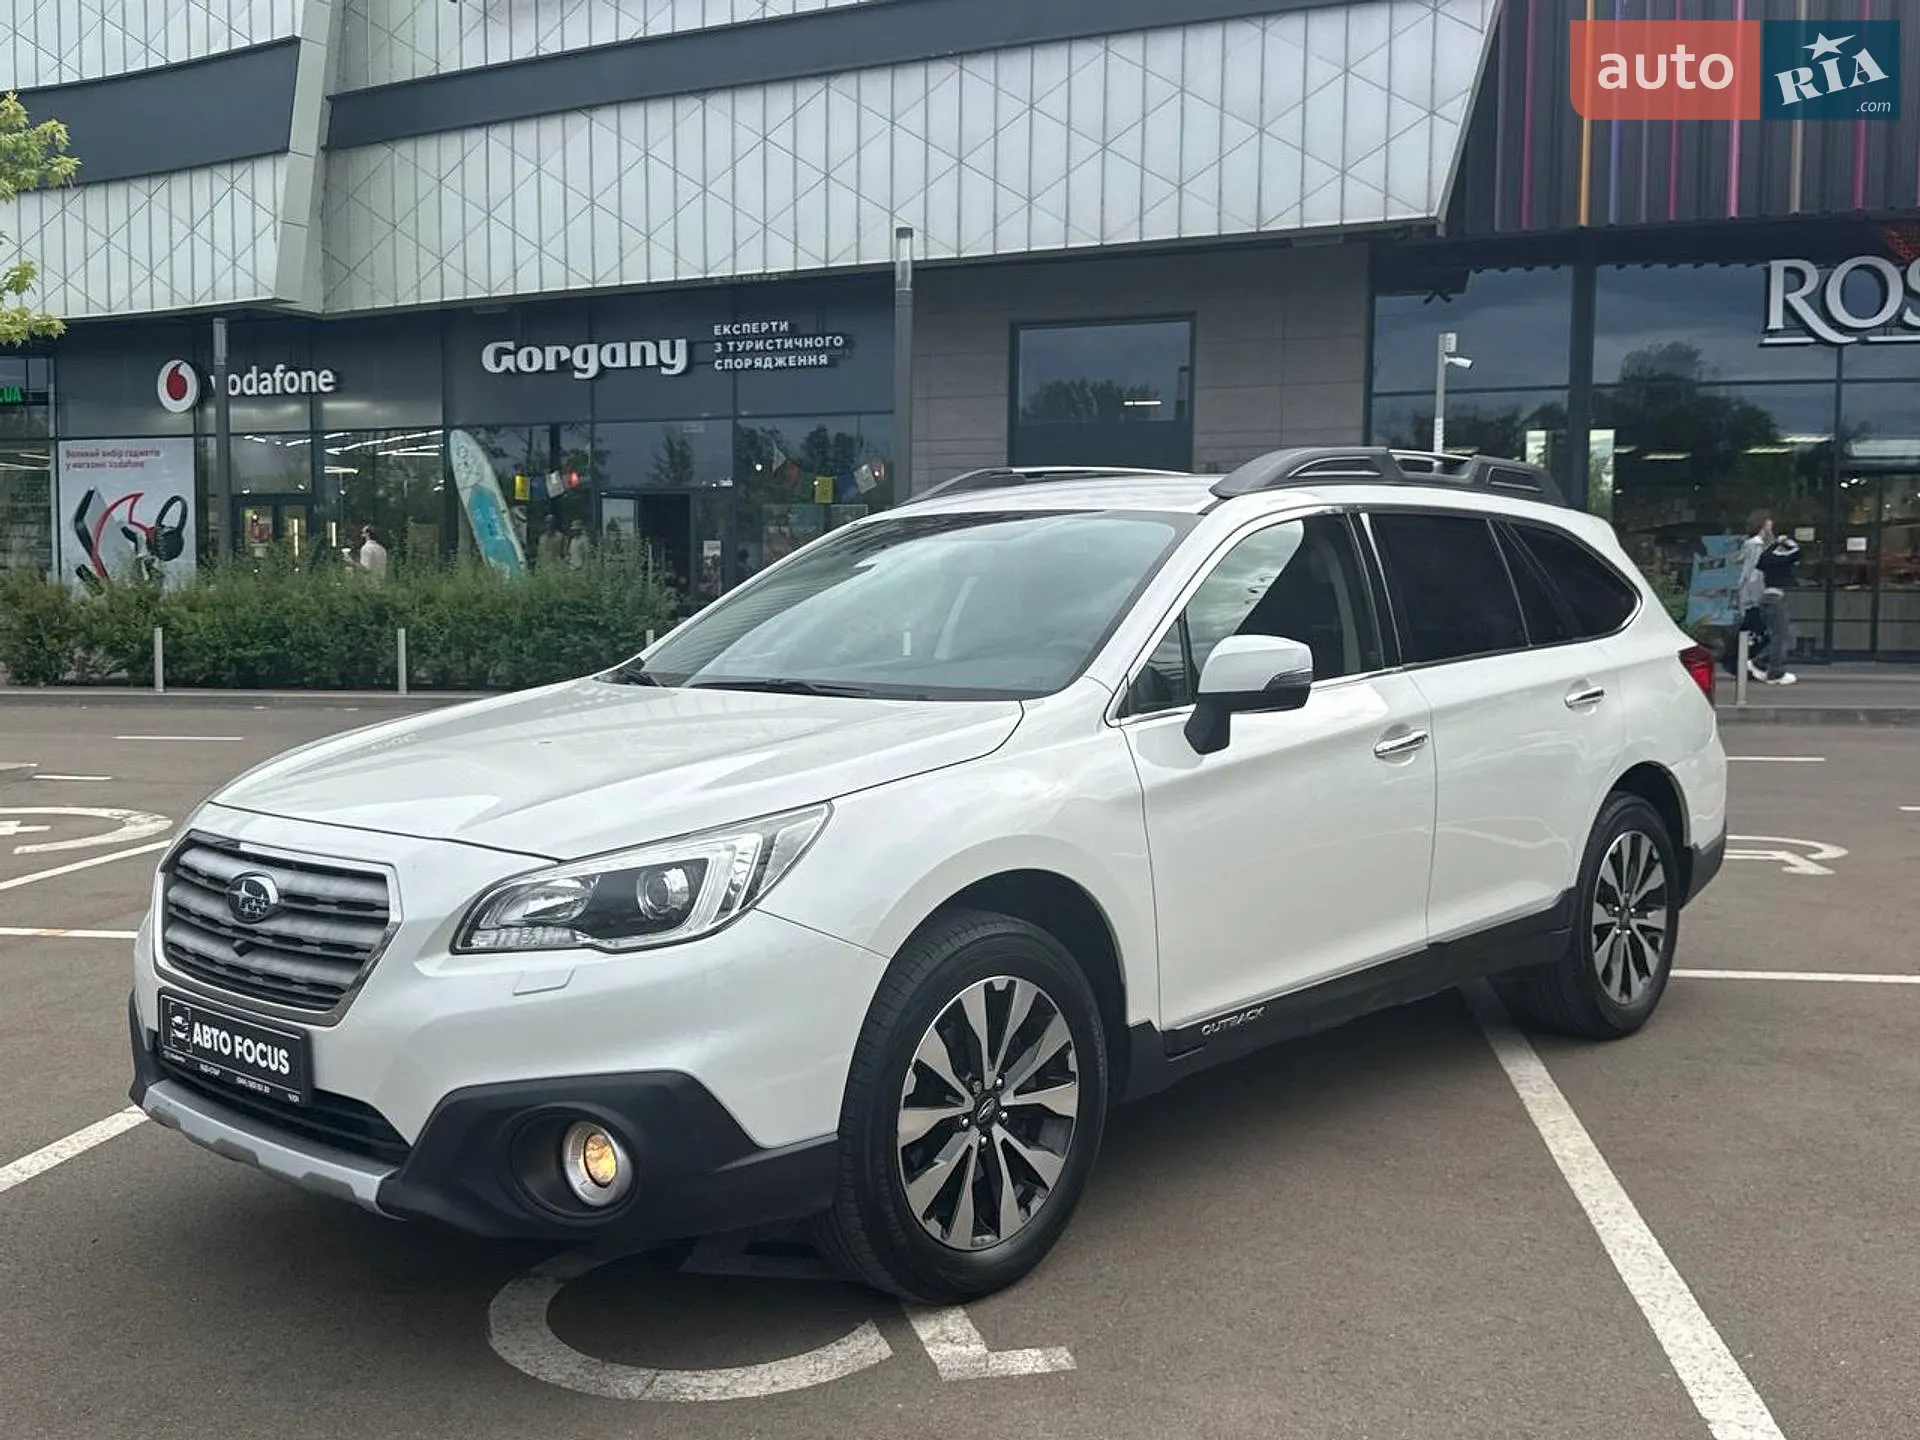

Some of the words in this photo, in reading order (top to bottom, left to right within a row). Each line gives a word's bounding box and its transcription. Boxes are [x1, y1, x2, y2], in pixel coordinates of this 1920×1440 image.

[713, 321, 789, 336] ЕКСПЕРТИ
[727, 335, 843, 353] ТУРИСТИЧНОГО
[481, 338, 687, 379] Gorgany
[714, 354, 829, 370] СПОРЯДЖЕННЯ
[234, 1034, 290, 1075] FOCUS
